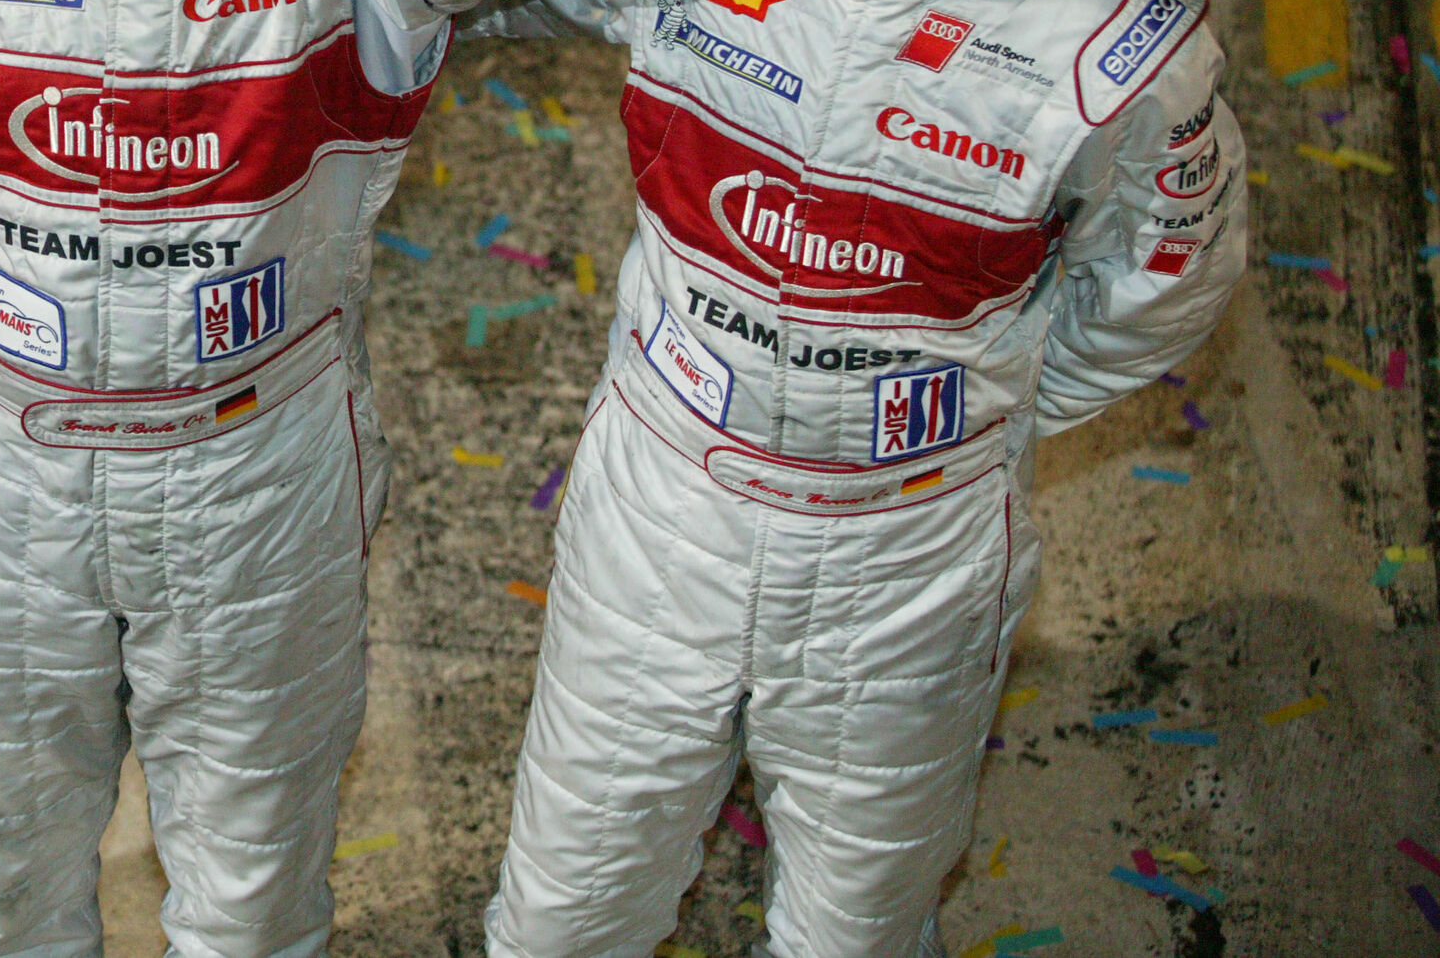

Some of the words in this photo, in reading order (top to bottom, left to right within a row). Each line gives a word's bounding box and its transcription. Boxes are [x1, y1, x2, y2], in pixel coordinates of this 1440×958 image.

[685, 27, 801, 96] MICHELIN
[962, 49, 1000, 69] North
[970, 37, 1001, 54] Audi
[1001, 46, 1036, 66] Sport
[875, 106, 1025, 180] Canon
[1151, 211, 1204, 230] TEAM
[111, 240, 241, 269] JOEST
[686, 286, 779, 357] TEAM
[790, 344, 921, 371] JOEST
[664, 338, 676, 357] LE
[674, 352, 702, 386] MANS
